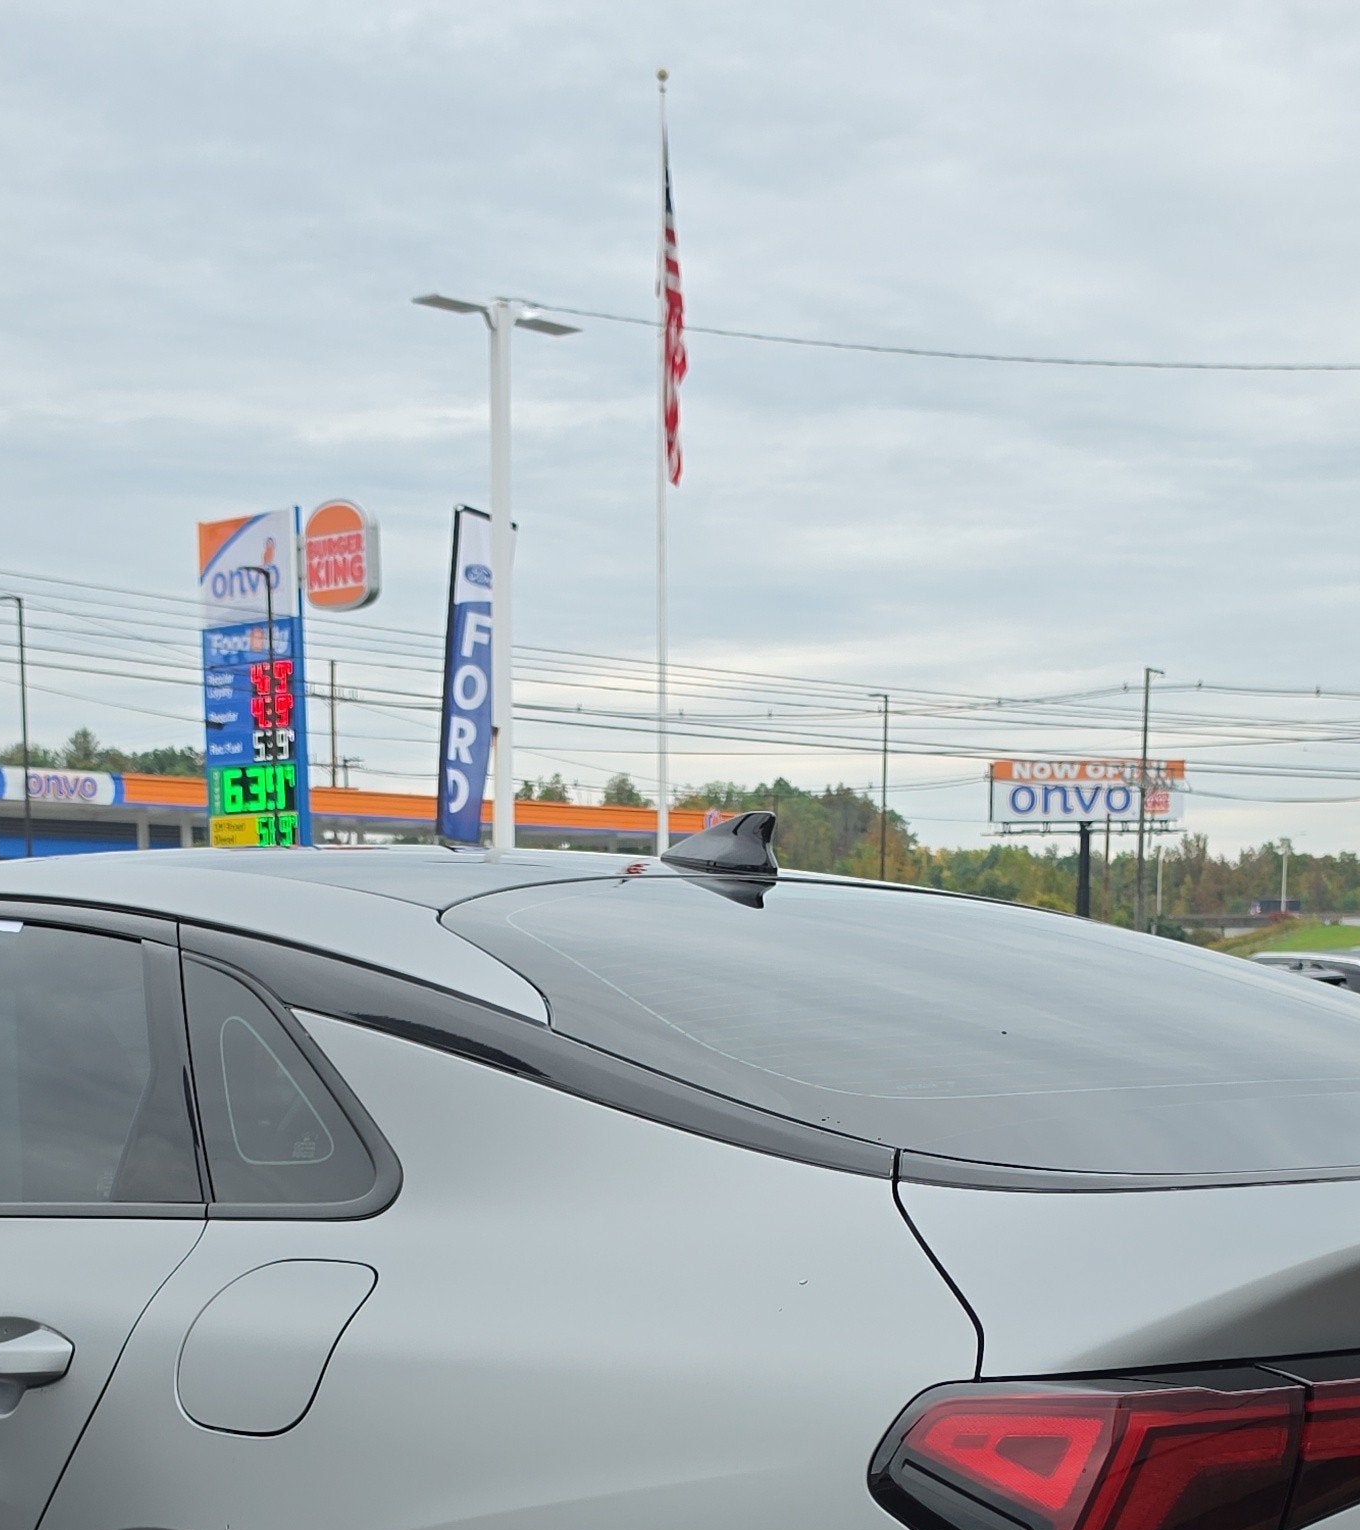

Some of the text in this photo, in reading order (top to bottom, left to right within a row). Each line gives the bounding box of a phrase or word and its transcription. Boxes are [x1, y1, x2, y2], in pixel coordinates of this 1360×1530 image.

[211, 560, 281, 600] onvo
[308, 554, 364, 590] KING
[448, 611, 492, 814] FORD
[27, 770, 98, 801] onvo
[1011, 761, 1078, 779] NOW
[1009, 784, 1132, 815] onvo
